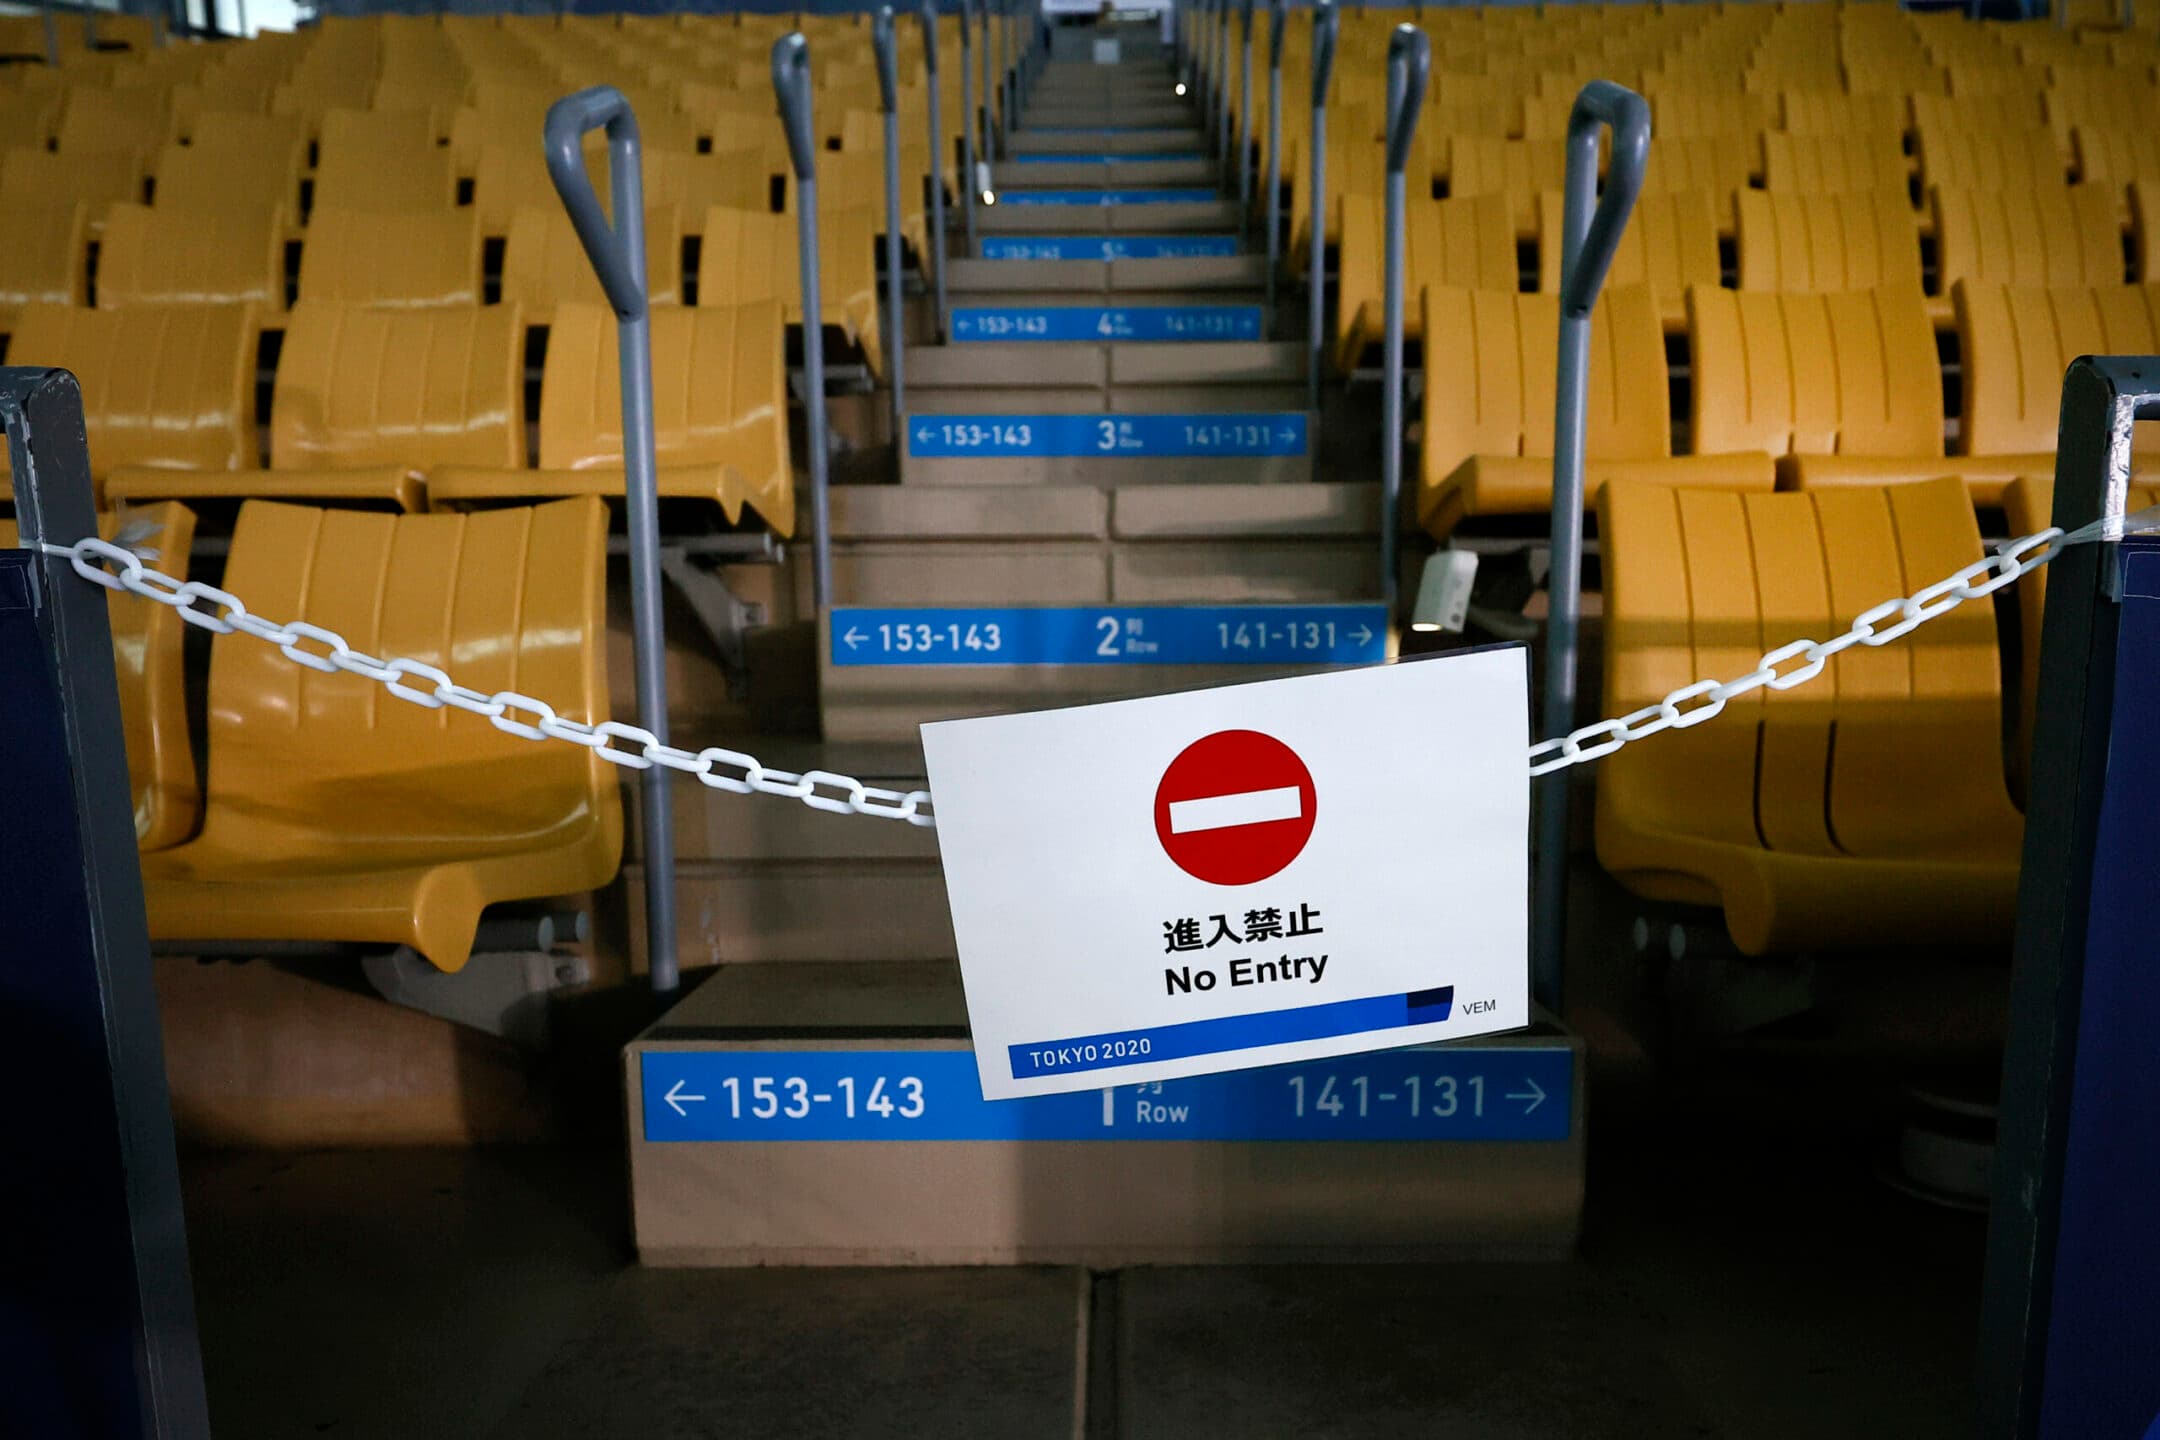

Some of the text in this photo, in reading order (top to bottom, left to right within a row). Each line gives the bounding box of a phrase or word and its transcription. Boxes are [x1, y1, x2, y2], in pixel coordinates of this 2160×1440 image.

[978, 316, 1047, 334] 153-143
[1098, 313, 1112, 336] 4
[943, 425, 1031, 446] 153-143
[1097, 420, 1116, 449] 3
[1185, 425, 1271, 446] 141-131
[879, 624, 1001, 651] 153-143
[1096, 616, 1120, 656] 2
[1126, 639, 1159, 653] Row
[1217, 622, 1337, 649] 141-131
[1163, 903, 1324, 953] 進入禁止
[1165, 954, 1329, 995] No Entry
[1462, 999, 1497, 1015] VEM
[1030, 1038, 1152, 1068] TOKYO 2020
[722, 1076, 925, 1119] 153-143
[1288, 1075, 1486, 1118] 141-131
[1137, 1100, 1189, 1123] Row
